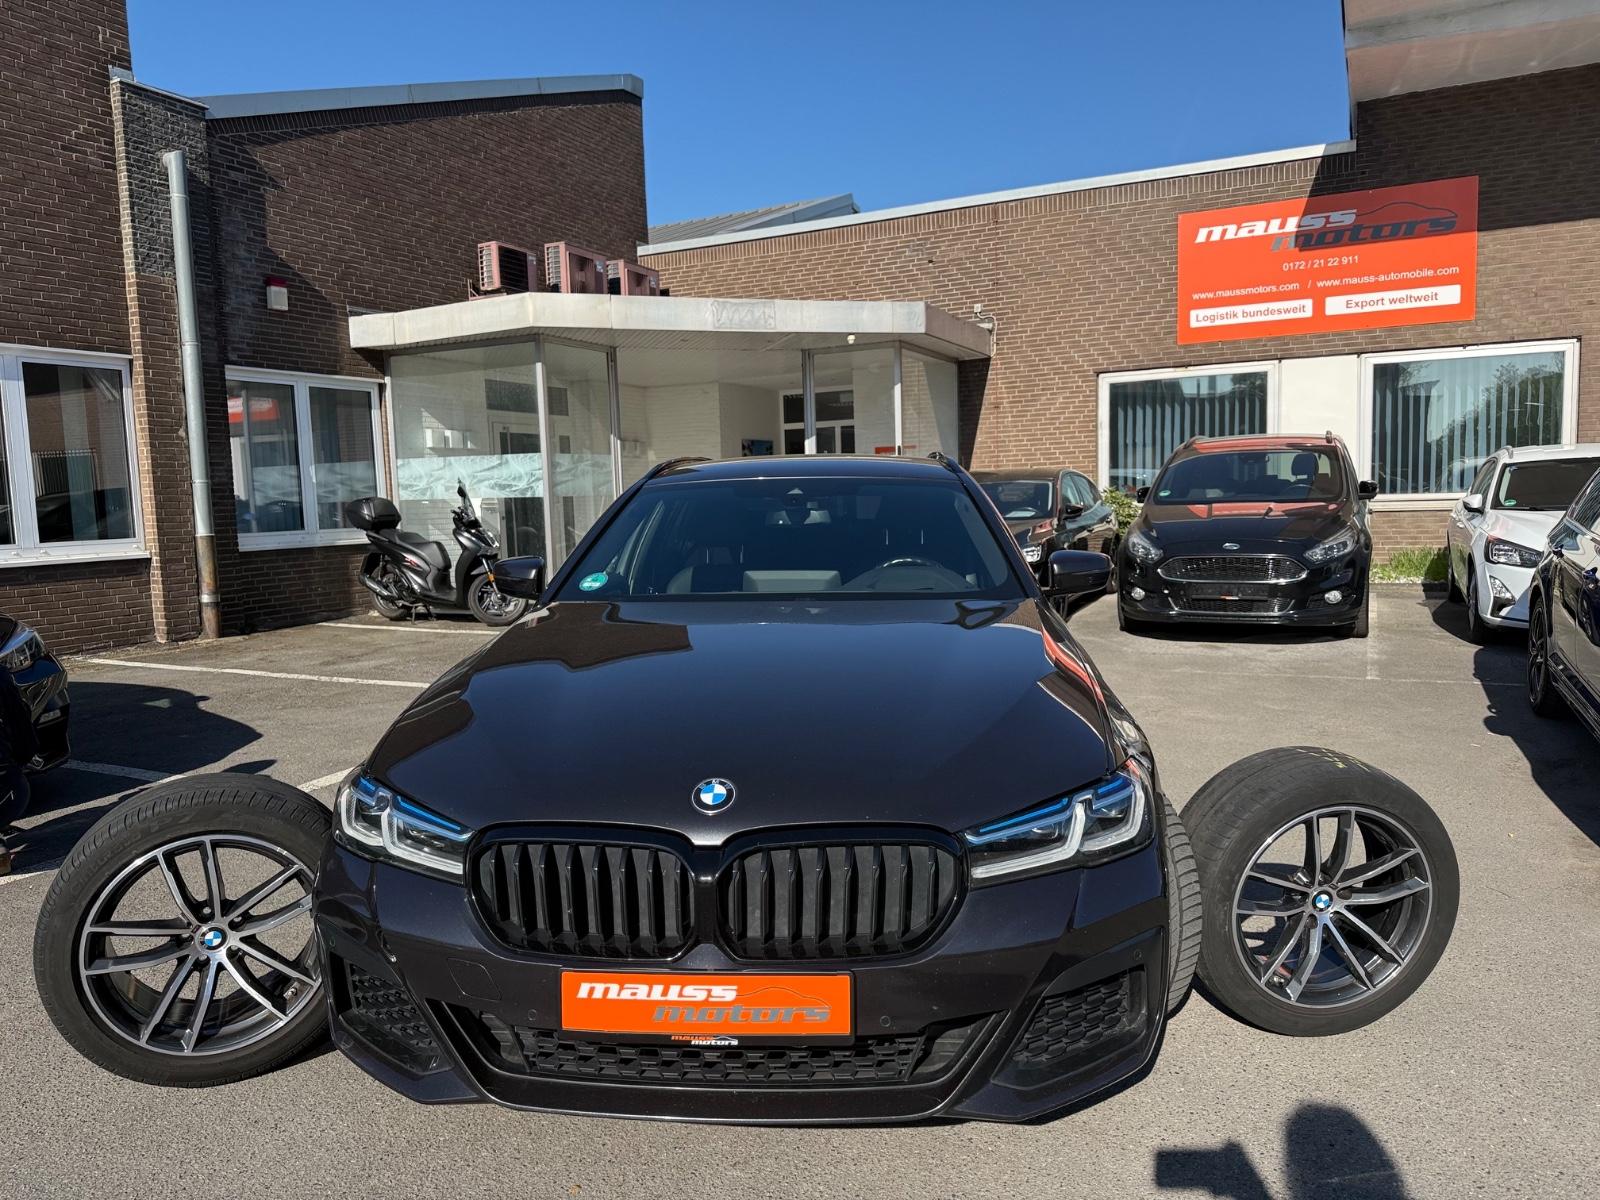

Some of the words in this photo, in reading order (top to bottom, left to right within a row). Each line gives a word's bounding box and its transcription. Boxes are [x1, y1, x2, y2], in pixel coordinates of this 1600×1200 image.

[1195, 209, 1357, 243] mauss
[1270, 215, 1457, 253] motors
[1282, 261, 1305, 272] 0172
[1313, 259, 1325, 268] 21
[1327, 257, 1339, 267] 22
[1341, 255, 1359, 265] 911
[1192, 282, 1300, 300] www.maussmotors.com
[1316, 266, 1460, 288] www.mauss-automobile.com
[1345, 298, 1385, 310] Export
[1388, 292, 1439, 305] weltweit
[1195, 310, 1239, 323] Logistik
[1242, 304, 1307, 318] bundesweit
[576, 981, 739, 1002] mauss
[653, 1005, 831, 1022] motors
